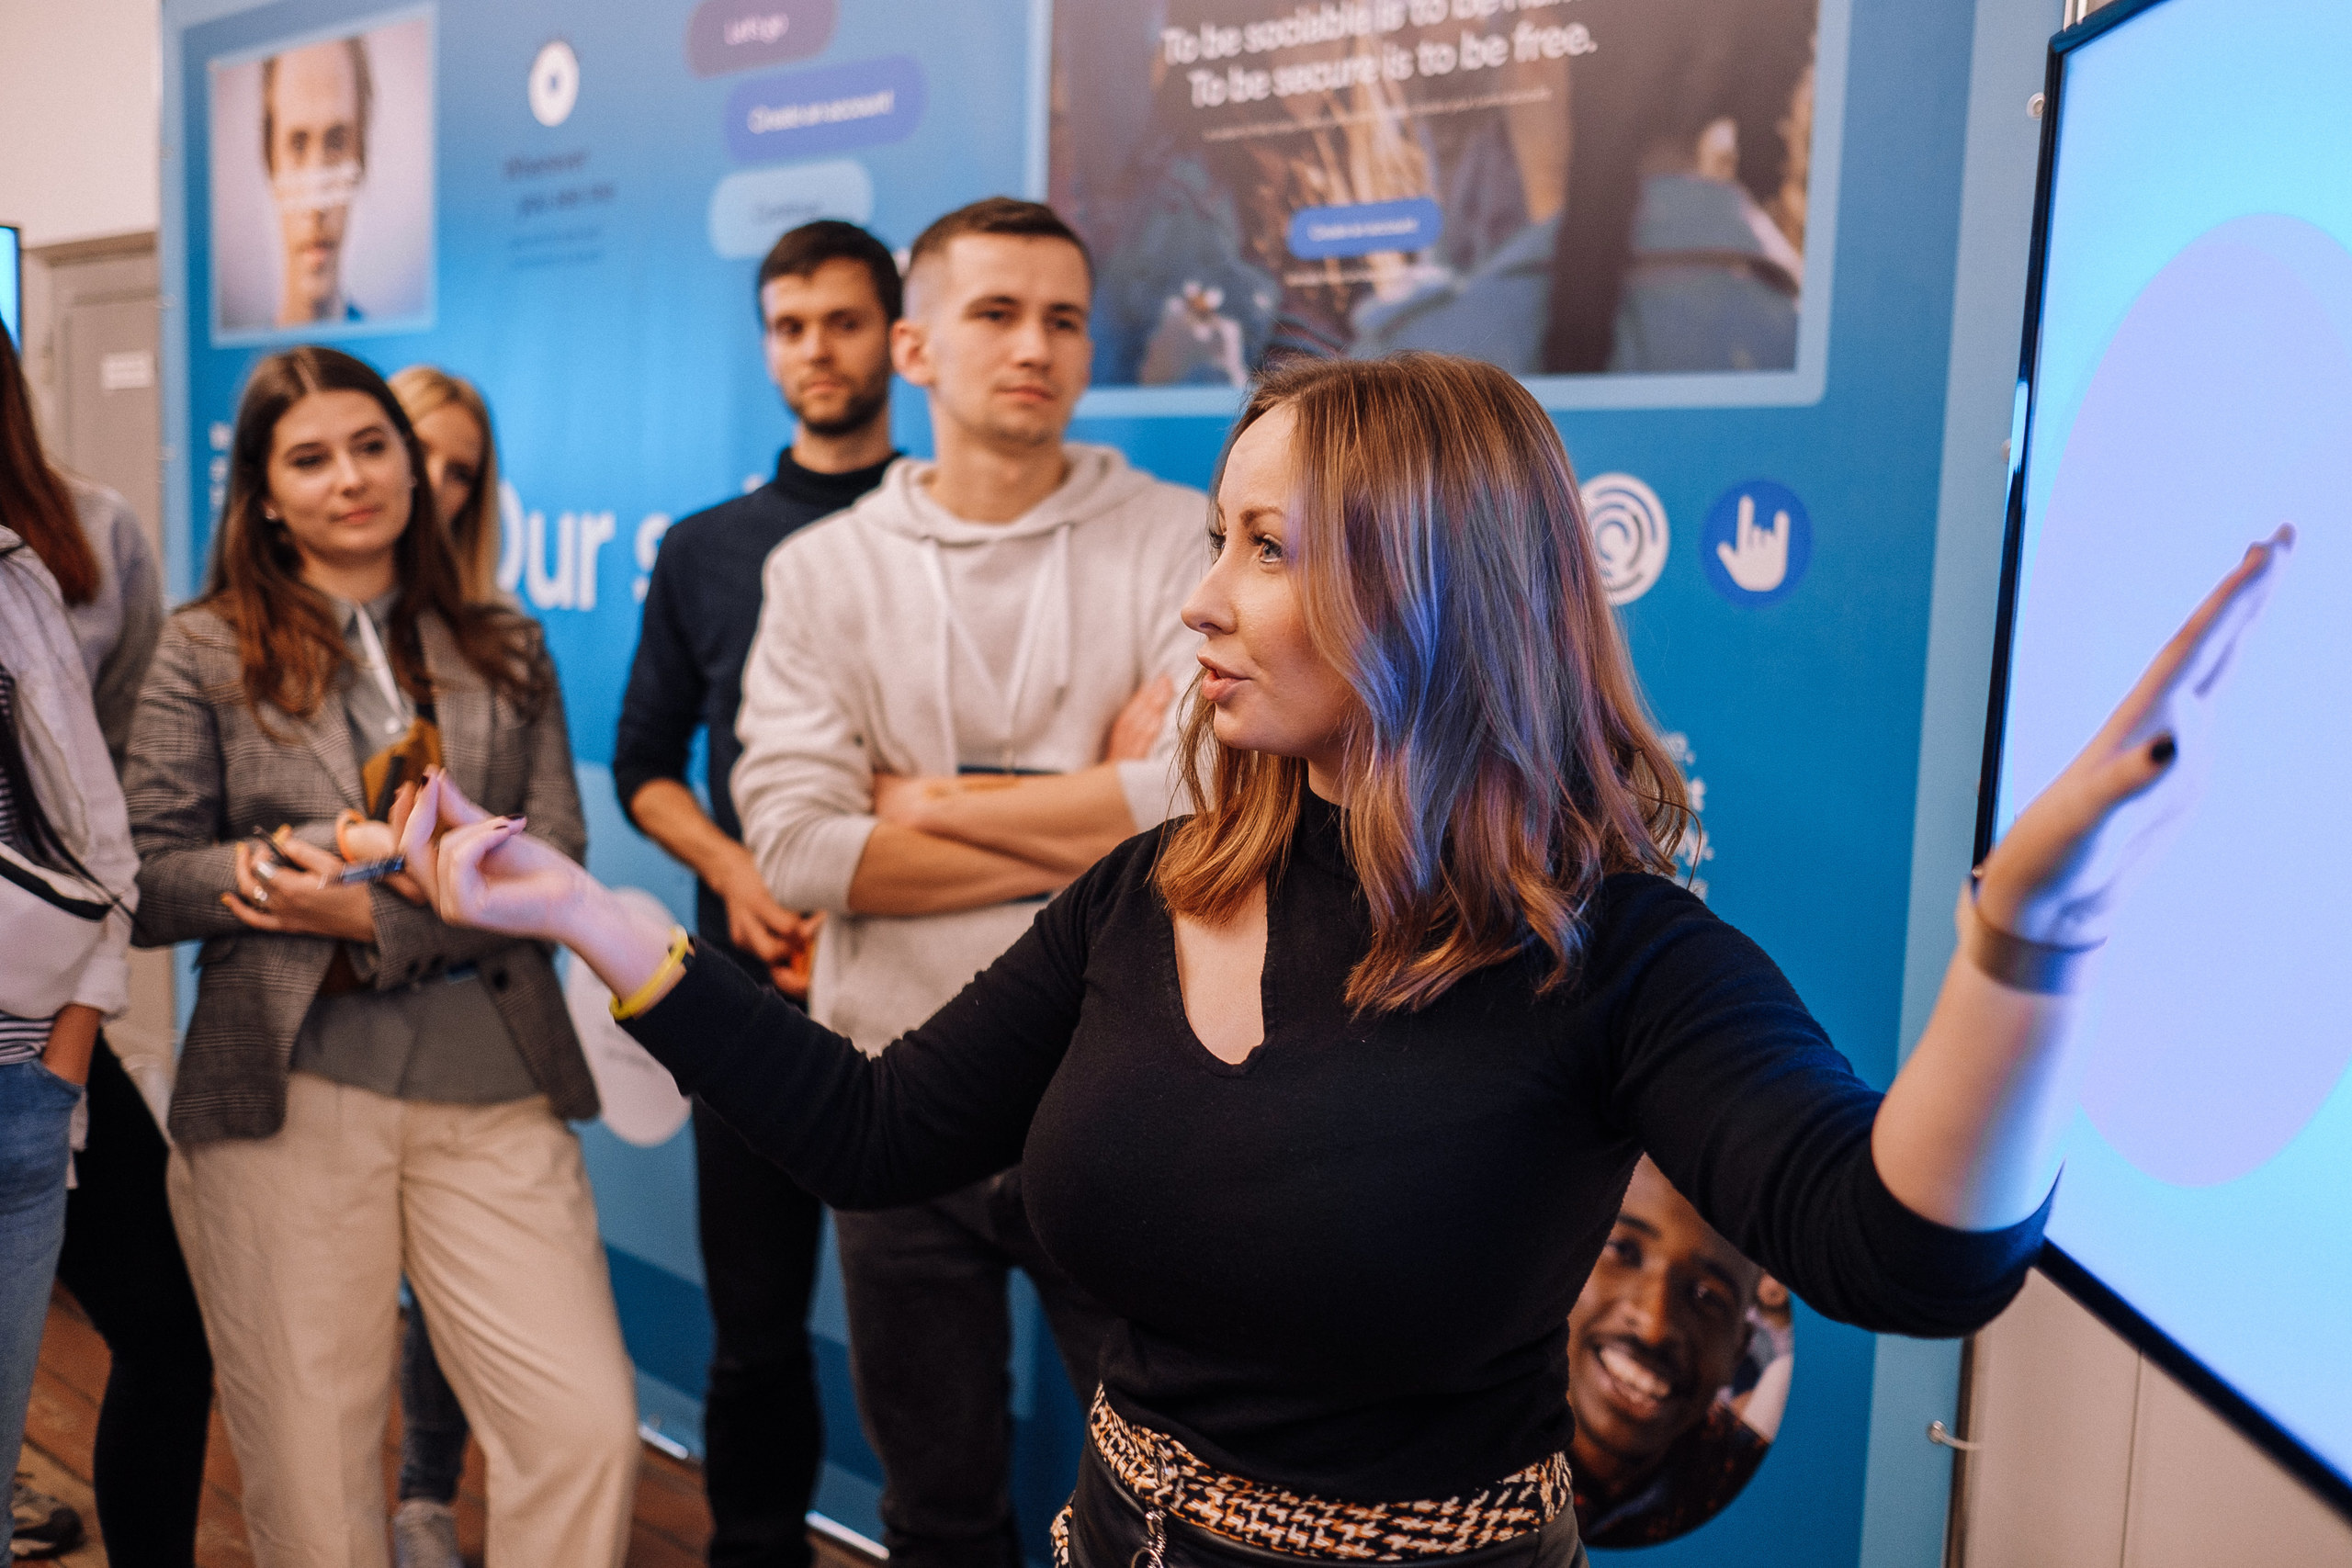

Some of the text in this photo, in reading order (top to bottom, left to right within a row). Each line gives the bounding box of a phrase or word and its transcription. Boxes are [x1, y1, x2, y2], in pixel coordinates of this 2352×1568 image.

[1162, 28, 1198, 64] To
[1200, 22, 1241, 60] be
[1243, 0, 1373, 53] sociable
[1376, 0, 1407, 32] is
[1409, 0, 1449, 27] to
[1188, 20, 1598, 107] To be secure is to be free.
